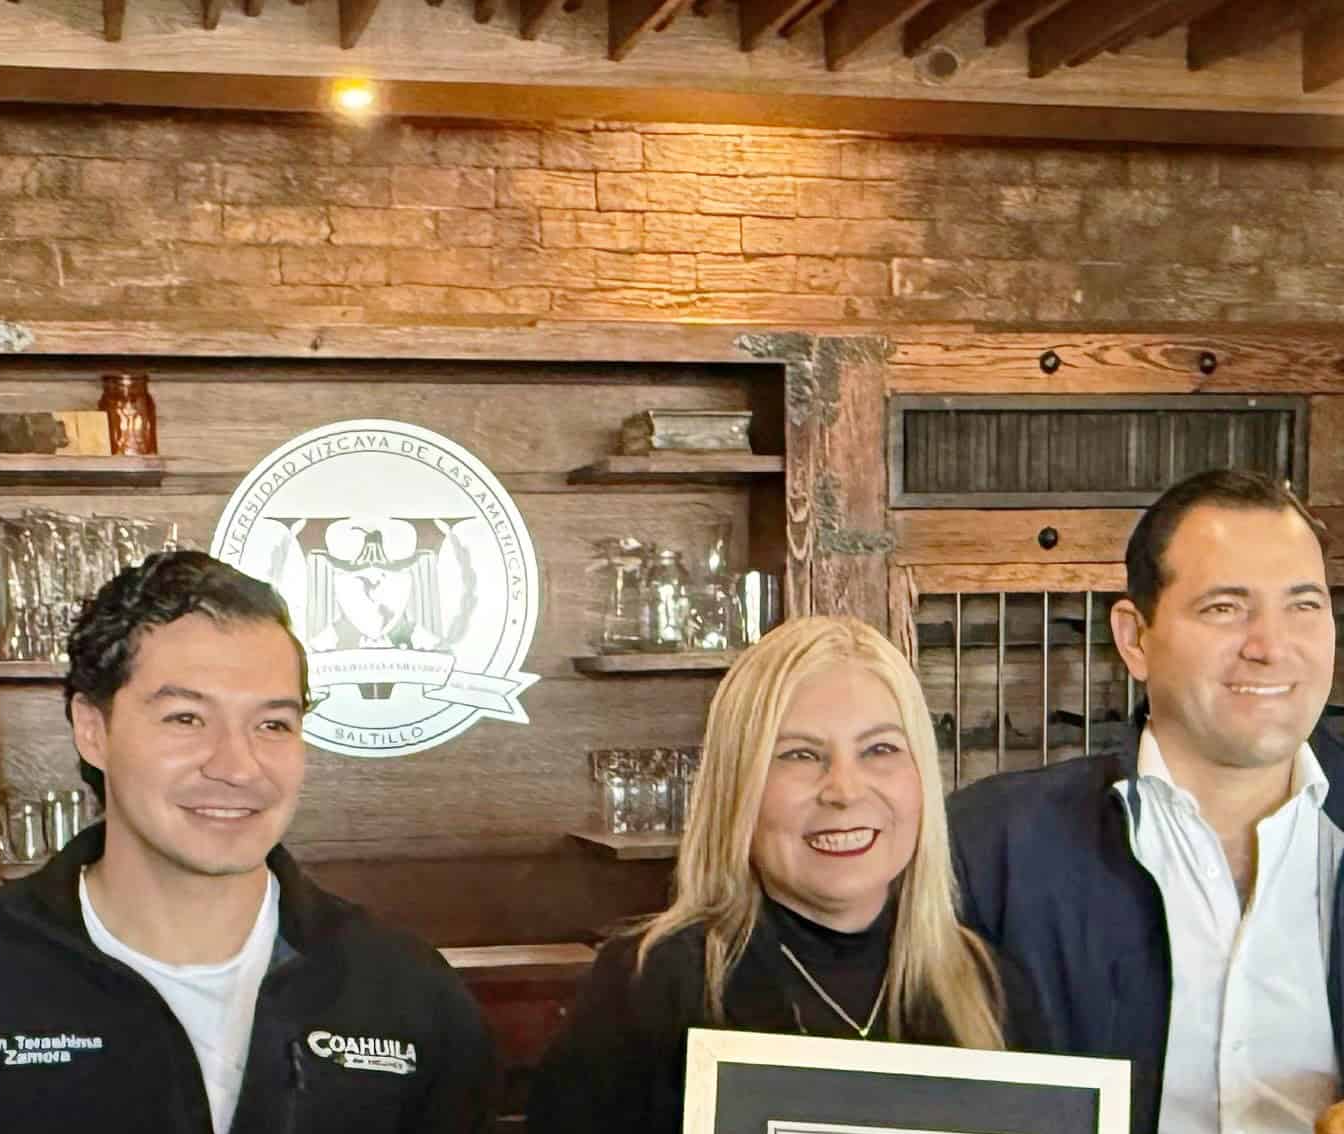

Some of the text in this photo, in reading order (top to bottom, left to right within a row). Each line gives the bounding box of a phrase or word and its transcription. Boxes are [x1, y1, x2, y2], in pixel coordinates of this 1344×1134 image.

[226, 435, 523, 601] VERSIDAD VIZCAYA DE LAS AMERICAS
[334, 726, 424, 745] SALTILLO
[307, 1030, 417, 1063] COAHUILA
